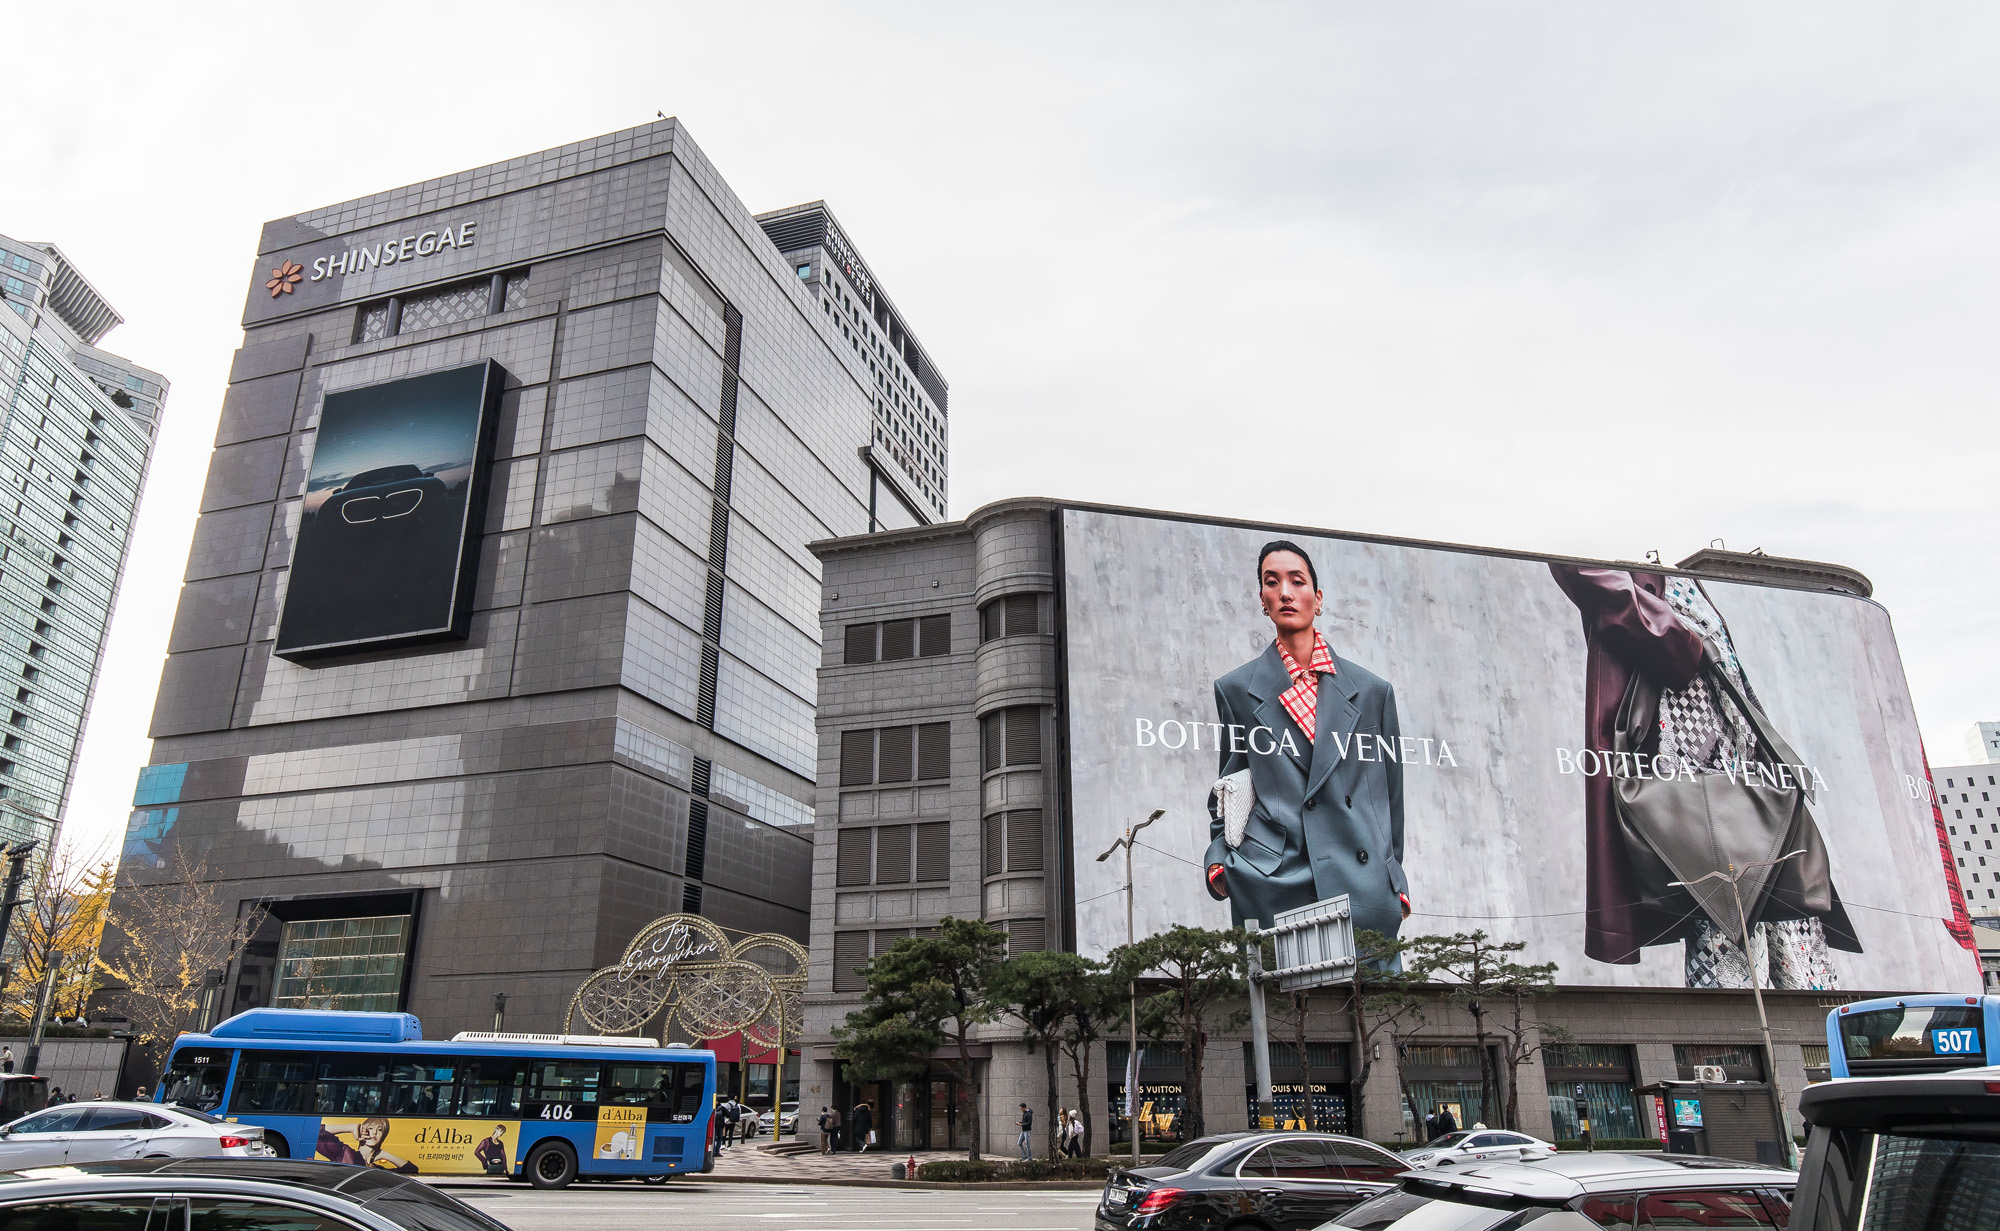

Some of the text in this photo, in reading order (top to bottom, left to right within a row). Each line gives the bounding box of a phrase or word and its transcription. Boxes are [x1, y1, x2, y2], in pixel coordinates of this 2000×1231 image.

[310, 220, 476, 282] SHINSEGAE
[826, 221, 871, 292] SHINSEGAE
[1134, 717, 1458, 768] BOTTEGA VENETA
[1555, 747, 1830, 792] BOTTEGA VENETA
[652, 917, 690, 953] Joy
[617, 940, 719, 983] Everywhere
[1938, 1030, 1972, 1052] 507
[193, 1056, 210, 1064] 1511
[1146, 1085, 1182, 1094] VUITTON
[1270, 1084, 1327, 1093] OUIS VUTON
[540, 1104, 573, 1120] 406
[602, 1108, 643, 1121] d'Alba
[414, 1126, 473, 1144] d'Alba
[426, 1153, 451, 1161] 프리미엄
